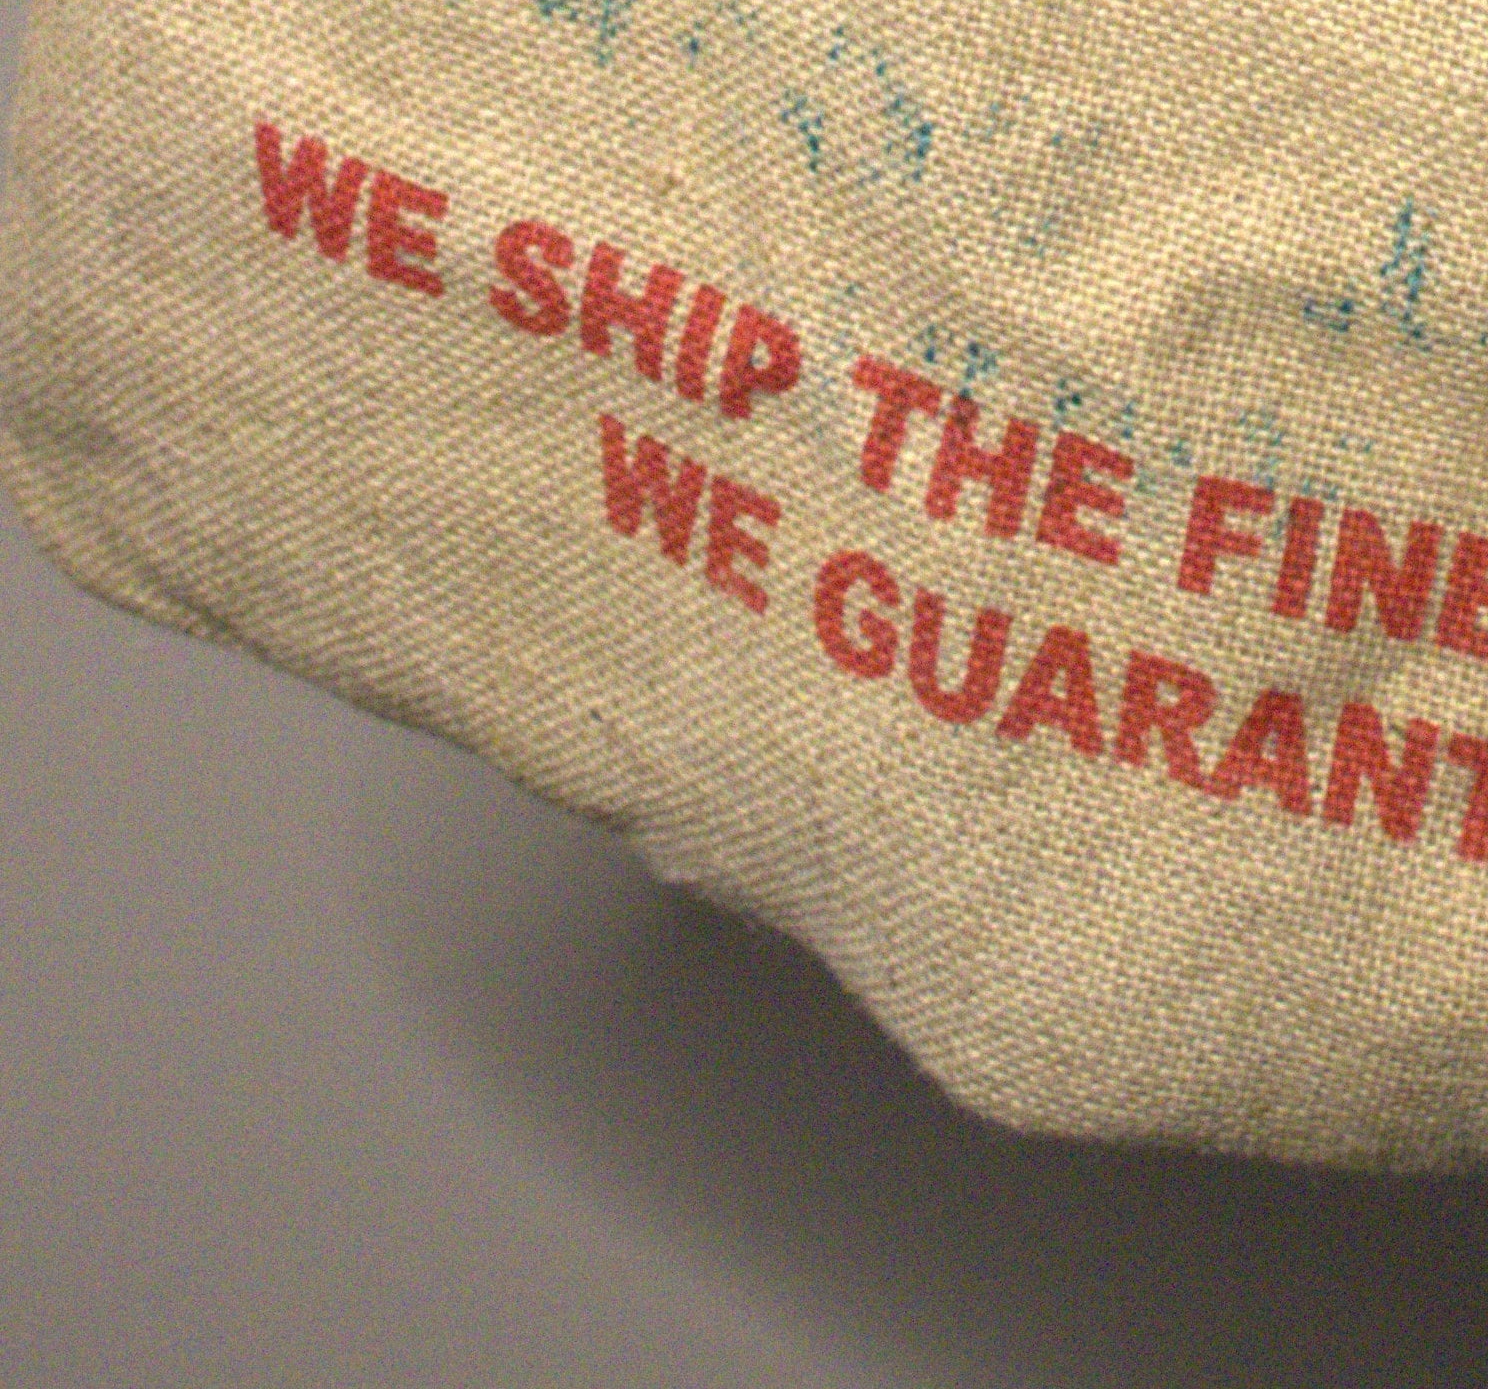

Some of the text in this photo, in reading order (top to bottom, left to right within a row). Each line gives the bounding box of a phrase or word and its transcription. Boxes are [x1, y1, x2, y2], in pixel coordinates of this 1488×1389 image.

[253, 118, 451, 297] WE
[487, 217, 804, 420] SHIP
[850, 351, 1135, 567] THE
[598, 413, 782, 614] WE
